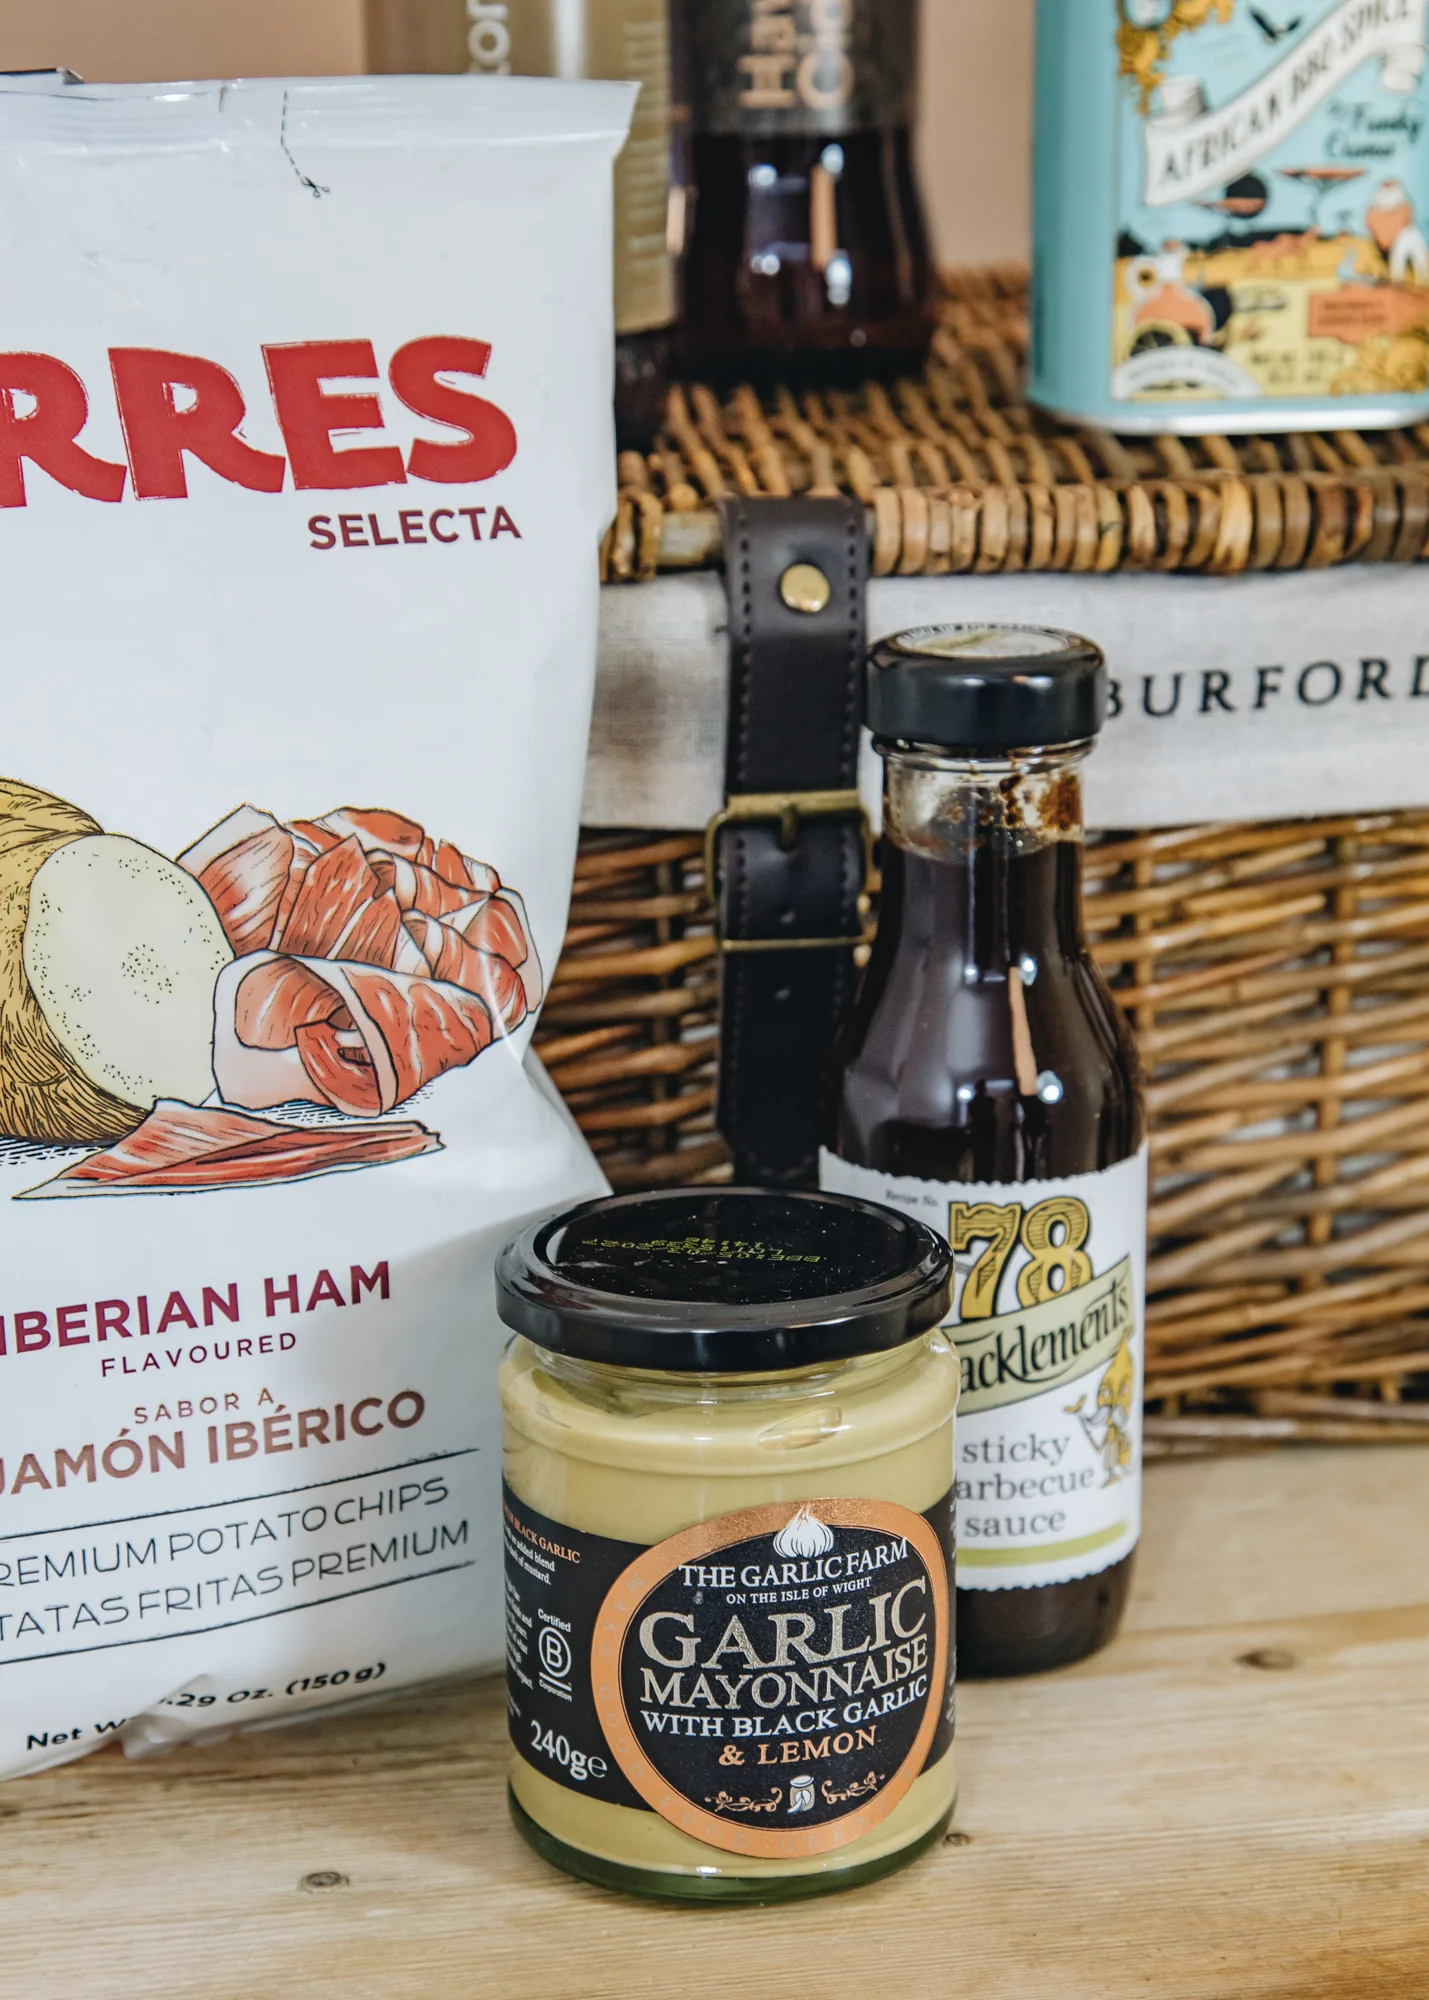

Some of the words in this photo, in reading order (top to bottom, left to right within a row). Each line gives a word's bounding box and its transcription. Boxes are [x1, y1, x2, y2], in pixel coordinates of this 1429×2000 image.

[307, 505, 523, 551] SELECTA
[948, 1196, 1094, 1323] 78
[0, 1282, 240, 1357] IBERIAN
[263, 1260, 390, 1318] HAM
[100, 1332, 297, 1378] FLAVOURED
[956, 1276, 1131, 1396] acklements
[134, 1391, 240, 1425] SABOR
[257, 1386, 275, 1406] A
[207, 1388, 426, 1465] IBÉRICO
[961, 1433, 1072, 1468] sticky
[956, 1467, 1095, 1502] arbecue
[168, 1503, 328, 1562] POTATO
[334, 1475, 449, 1527] CHIPS
[514, 1517, 538, 1546] BLACK
[539, 1536, 581, 1564] GARLIC
[963, 1508, 1067, 1539] sauce
[138, 1565, 284, 1620] FRITAS
[291, 1518, 469, 1588] PREMIUM
[533, 1551, 556, 1573] blend
[678, 1564, 736, 1588] THE
[740, 1555, 843, 1588] GARLIC
[845, 1536, 908, 1577] FARM
[725, 1592, 747, 1606] ON
[749, 1590, 778, 1605] THE
[780, 1588, 810, 1603] ISLE
[812, 1585, 829, 1599] OF
[831, 1576, 873, 1596] WIGHT
[537, 1607, 572, 1633] Certified
[638, 1575, 927, 1671] GARLIC
[546, 1635, 563, 1669] B
[639, 1636, 929, 1711] MAYONNAISE
[538, 1678, 573, 1703] Corporation
[640, 1709, 725, 1738] WITH
[730, 1707, 839, 1739] BLACK
[842, 1674, 928, 1726] GARLIC
[26, 1727, 82, 1751] Net
[157, 1692, 217, 1709] .29
[226, 1687, 275, 1704] Oz.
[717, 1743, 746, 1767] &
[756, 1724, 877, 1766] LEMON
